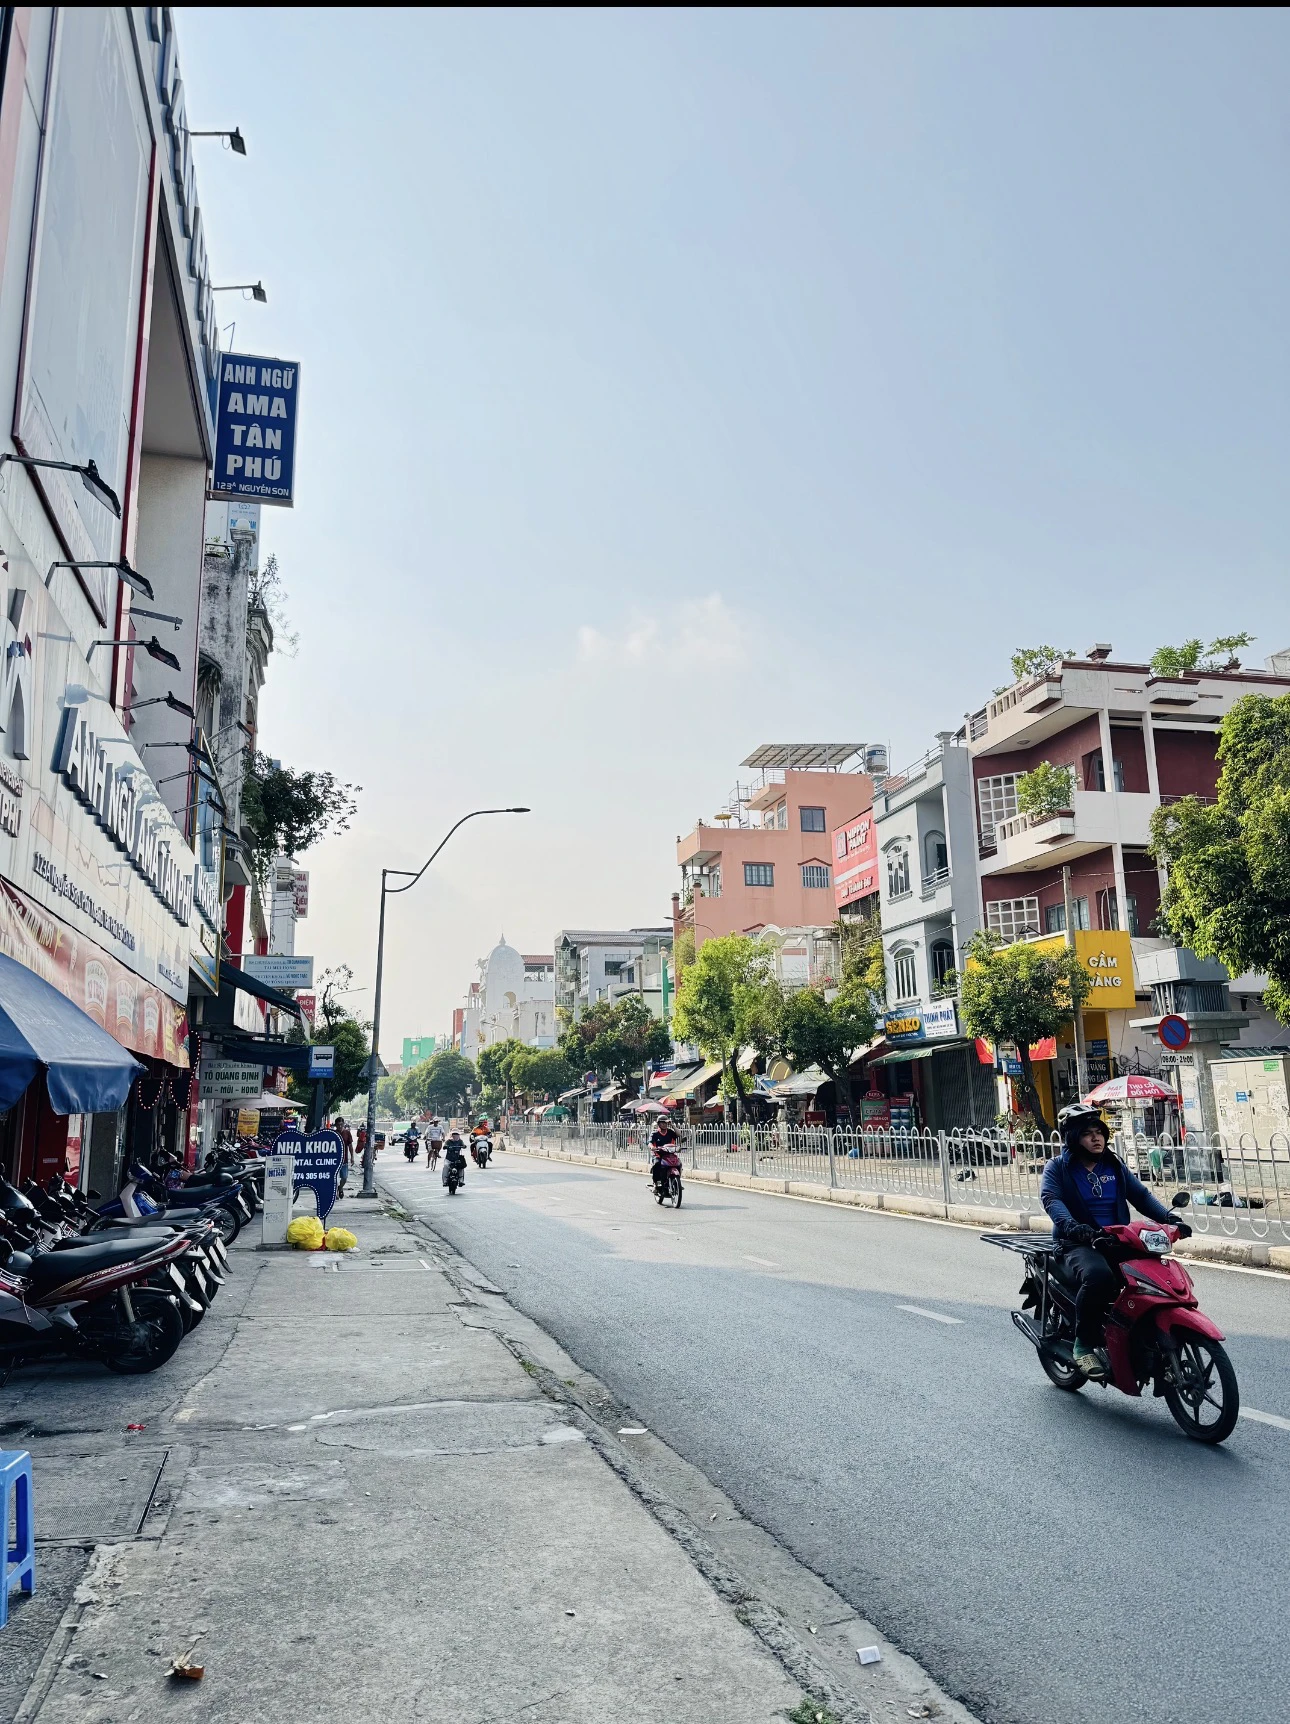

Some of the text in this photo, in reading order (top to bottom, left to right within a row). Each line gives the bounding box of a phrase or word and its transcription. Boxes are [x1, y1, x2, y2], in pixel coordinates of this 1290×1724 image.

[224, 364, 295, 390] ANH NGỮ
[227, 392, 287, 419] AMA
[230, 423, 282, 450] TÂN
[226, 454, 281, 480] PHÚ
[58, 706, 108, 817] ANH
[130, 809, 160, 890] AMA
[846, 819, 871, 841] NIPPON
[849, 832, 868, 851] PAINT
[1088, 950, 1118, 968] CẦM
[886, 1017, 921, 1034] SENKO
[204, 1070, 259, 1082] TÔ QUANG ĐỊNH
[203, 1086, 213, 1094] TAI
[277, 1141, 337, 1154] NHA KHOA
[315, 1158, 337, 1166] CLINIC
